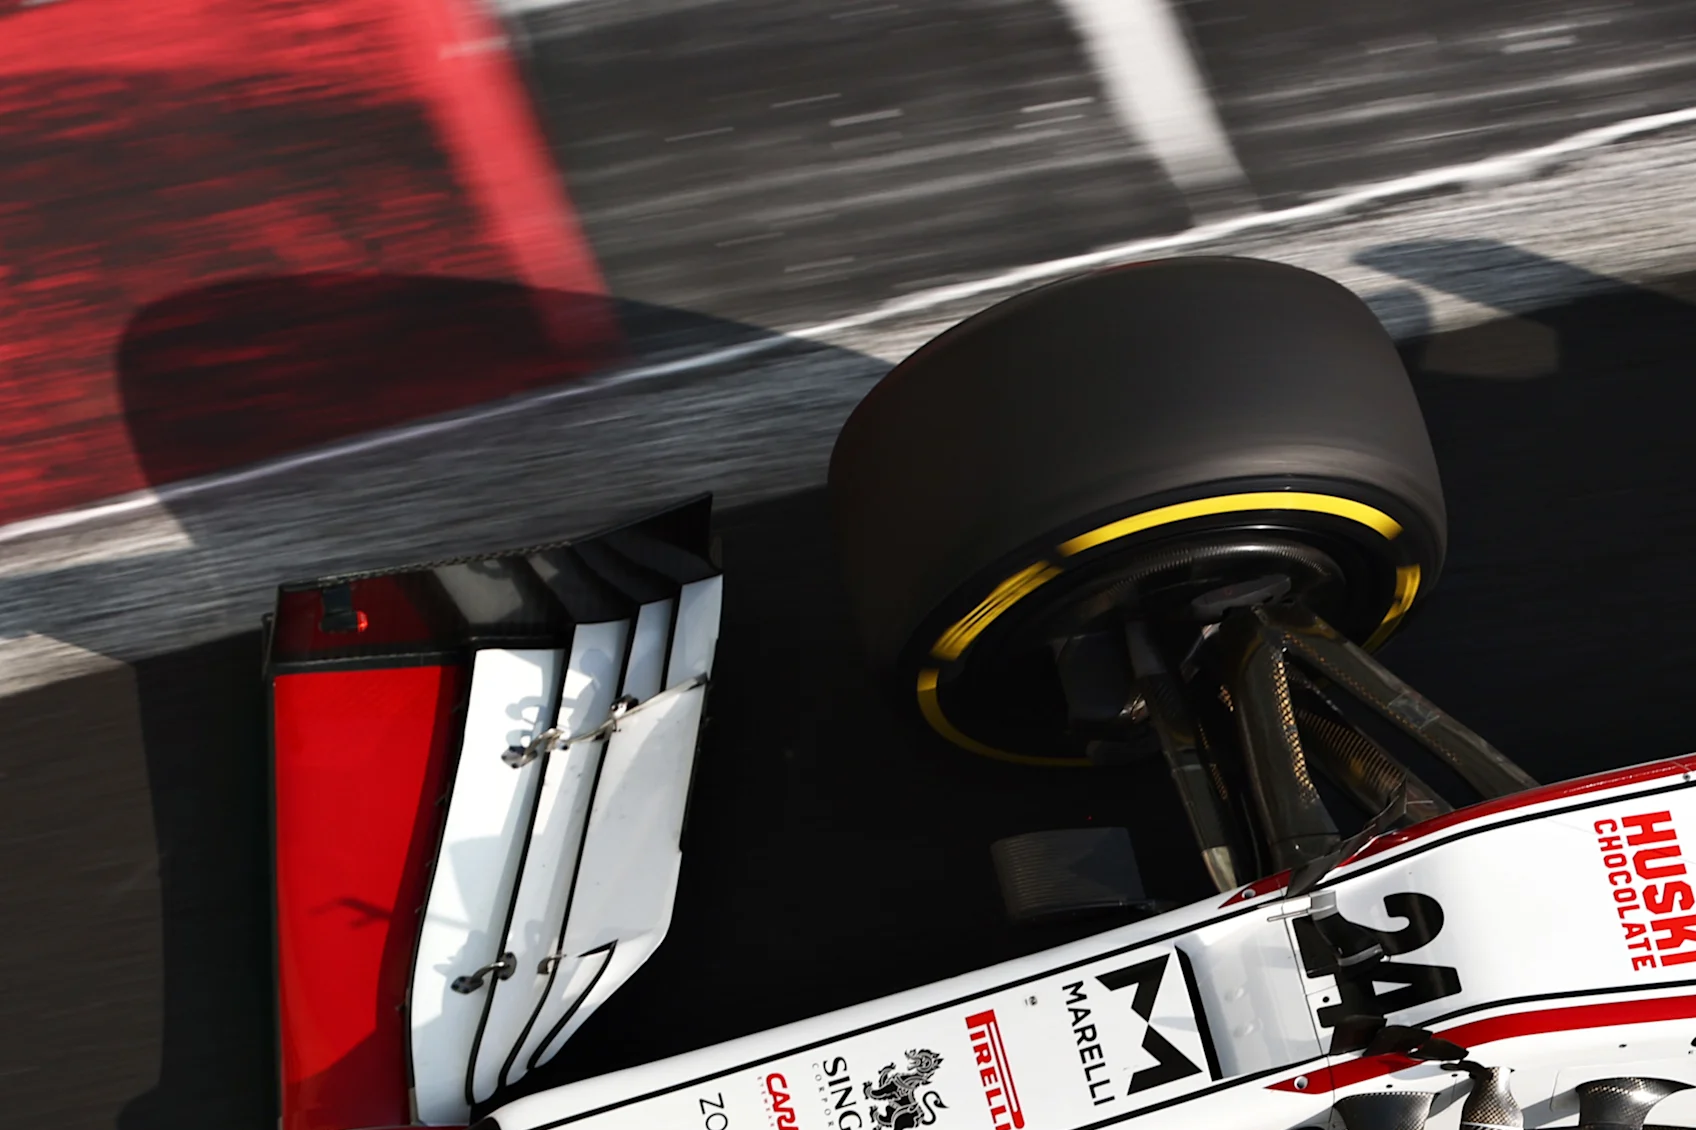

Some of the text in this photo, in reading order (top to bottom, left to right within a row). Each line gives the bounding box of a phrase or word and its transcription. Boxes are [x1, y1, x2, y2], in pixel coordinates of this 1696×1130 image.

[1301, 892, 1462, 1035] 24
[1593, 818, 1657, 972] CHOCOLATE
[1062, 980, 1115, 1106] MARELLI
